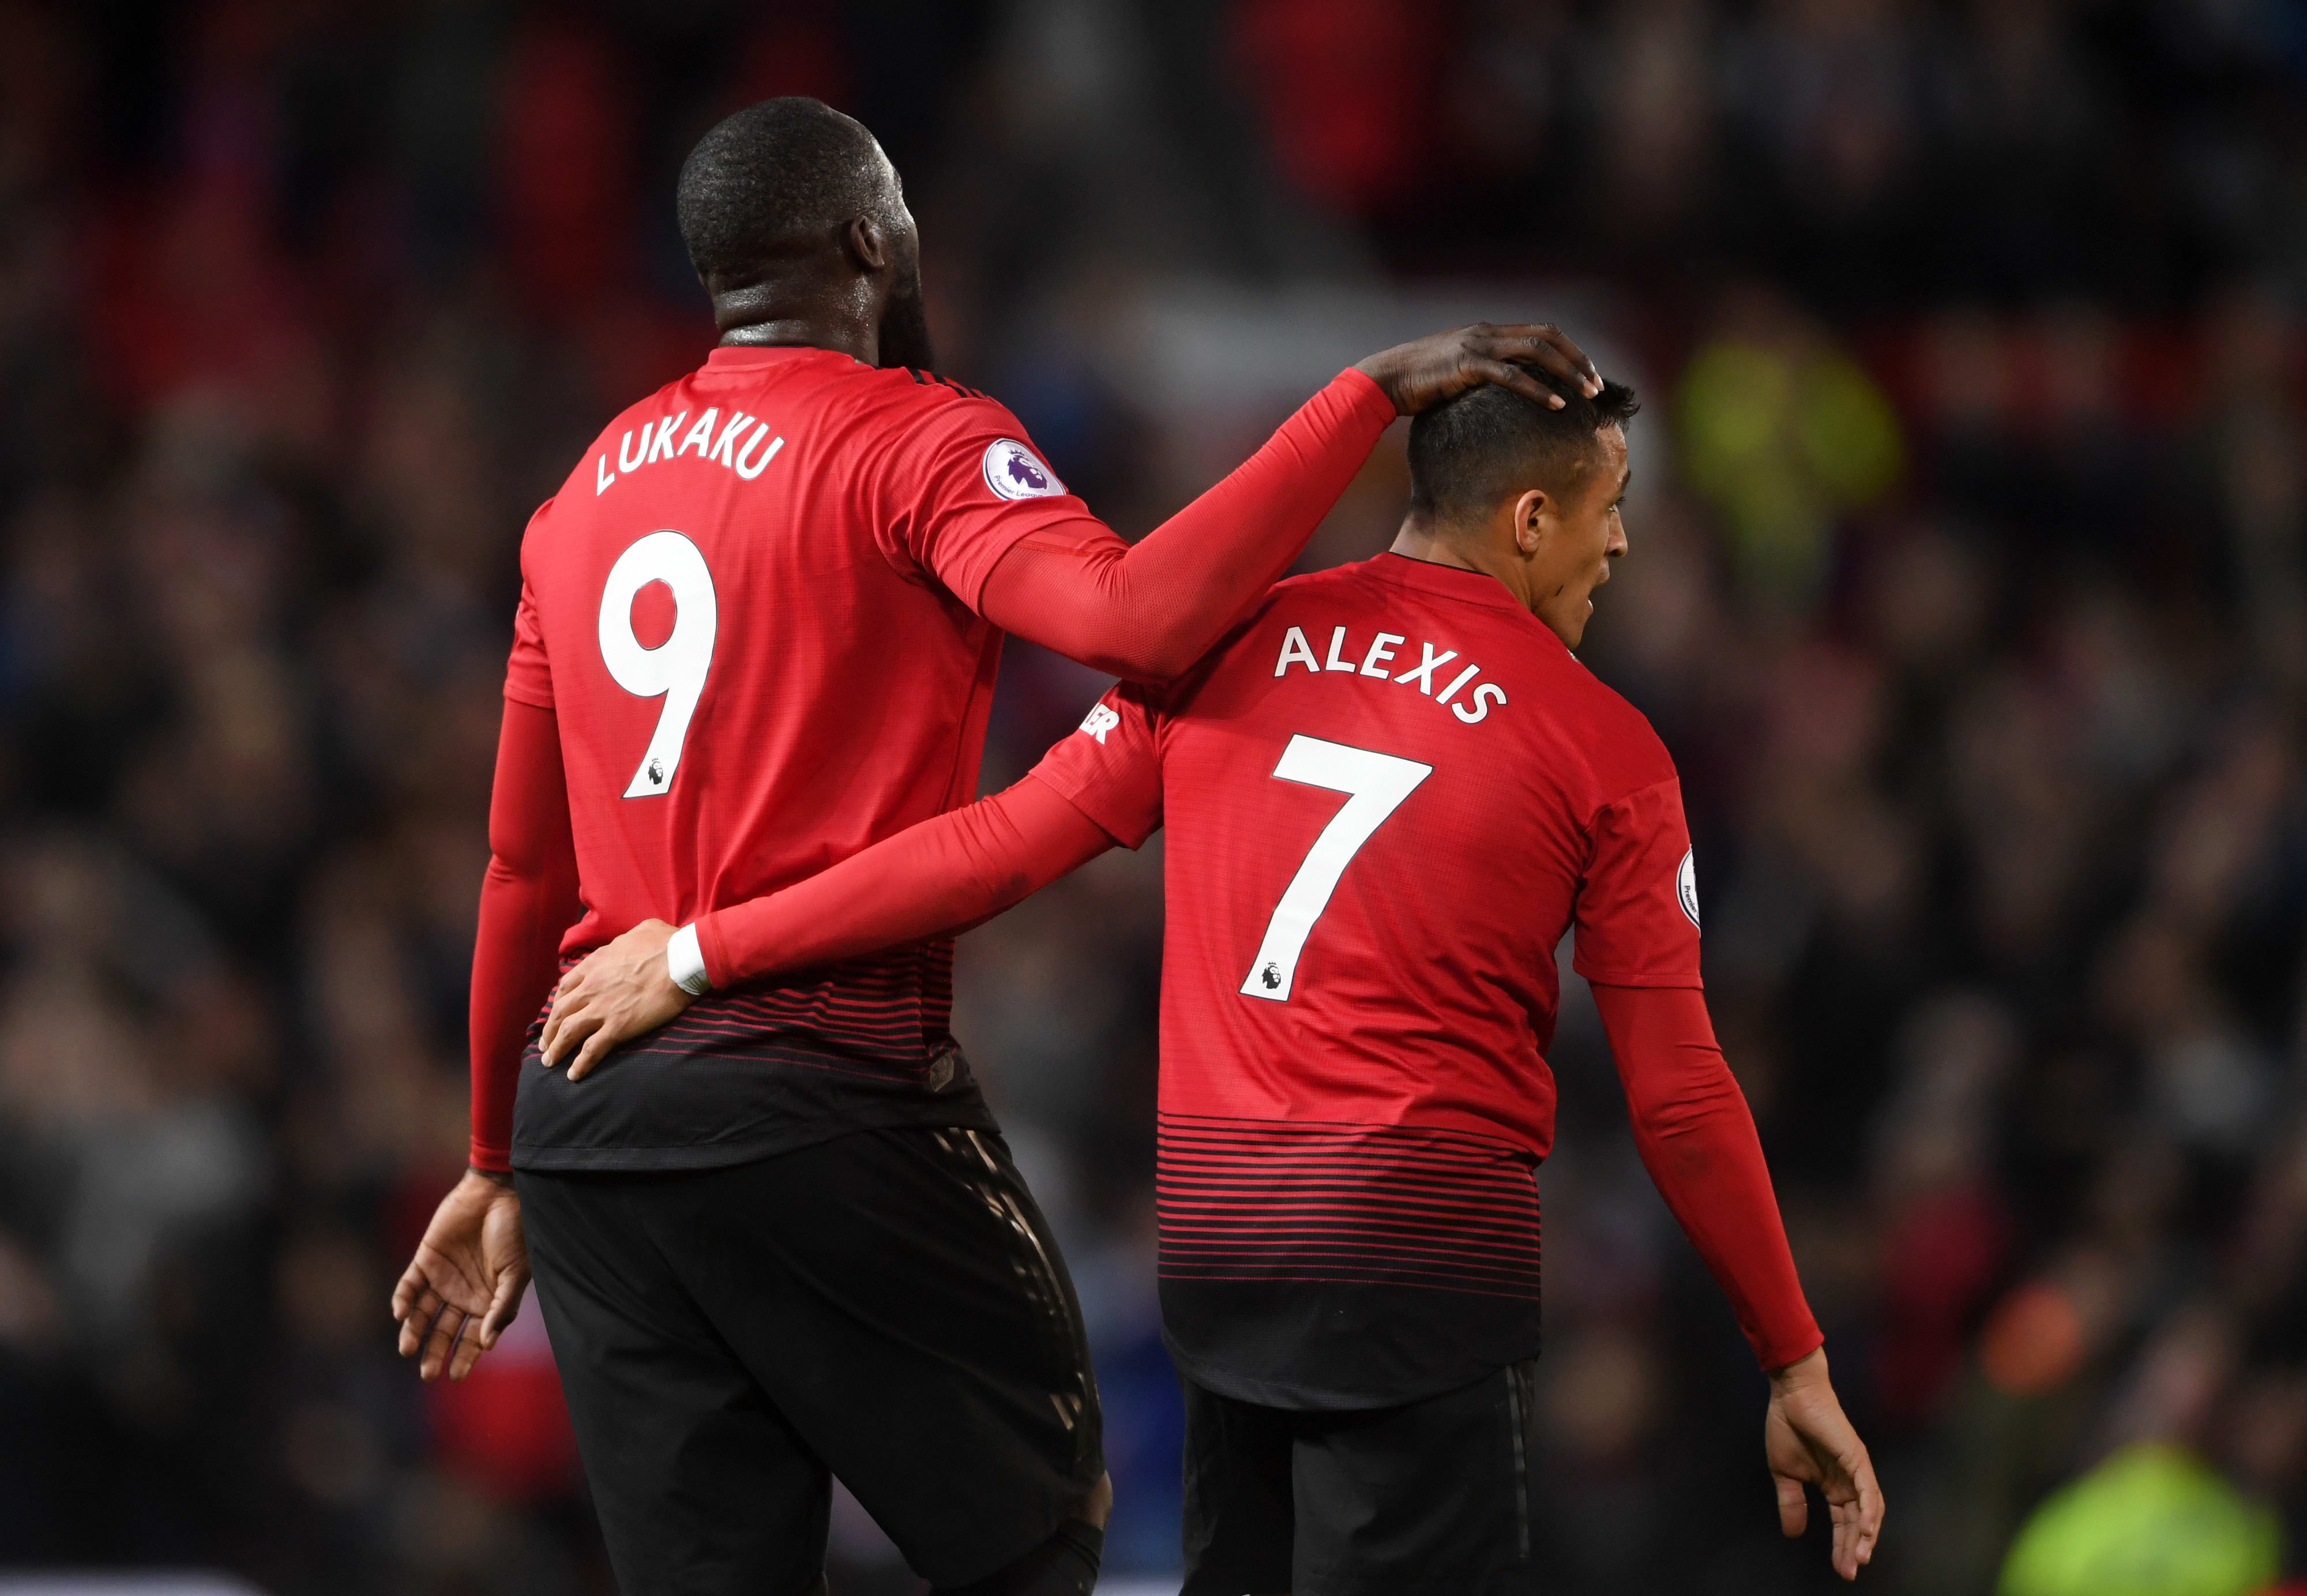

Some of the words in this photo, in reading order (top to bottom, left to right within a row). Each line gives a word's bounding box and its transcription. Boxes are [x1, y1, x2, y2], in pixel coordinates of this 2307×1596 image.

[596, 407, 785, 497] LUKAKU
[994, 475, 1015, 494] Premier
[598, 529, 718, 798] 9
[1273, 626, 1508, 724] ALEXIS
[1239, 733, 1434, 1001] 7
[1684, 885, 1697, 912] Premier
